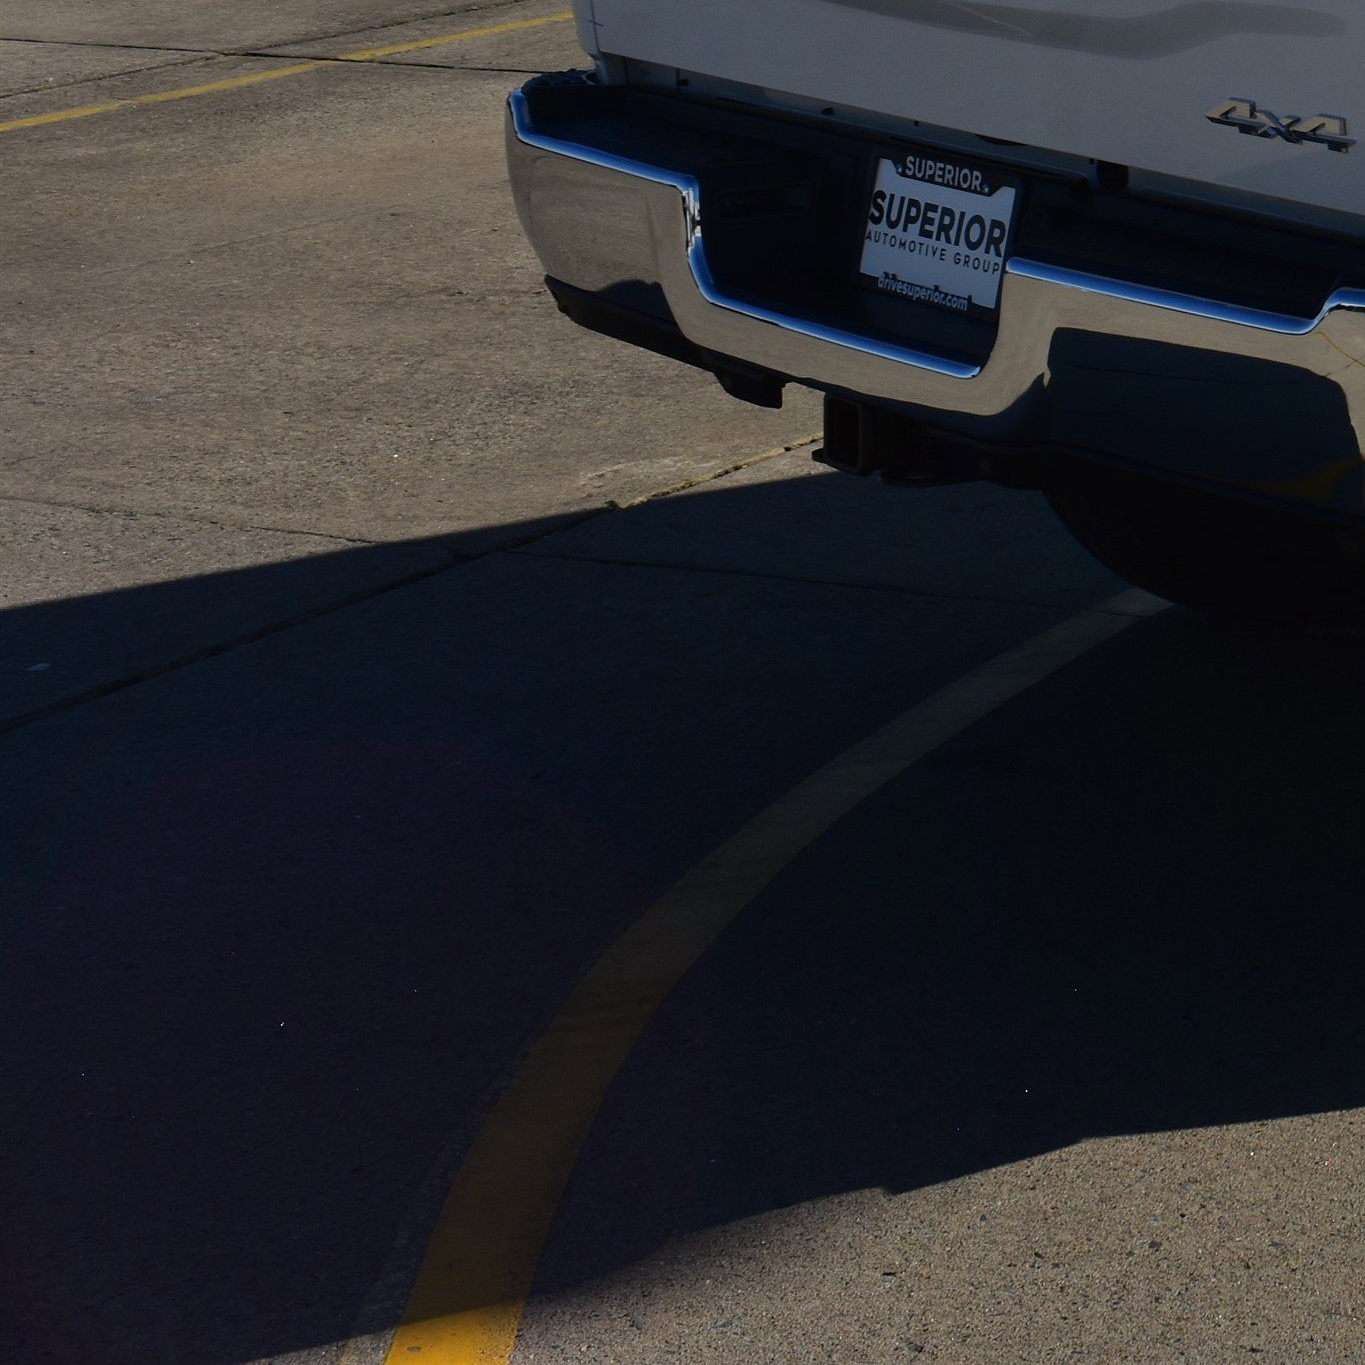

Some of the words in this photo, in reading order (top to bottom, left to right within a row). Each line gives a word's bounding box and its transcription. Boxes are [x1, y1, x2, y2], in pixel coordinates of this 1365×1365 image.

[905, 155, 983, 193] SUPERIOR
[868, 189, 1007, 259] SUPERIOR
[865, 229, 947, 261] AUTOMOTIVE
[953, 251, 1001, 276] GROUP
[877, 272, 969, 312] drivesuperior.com
